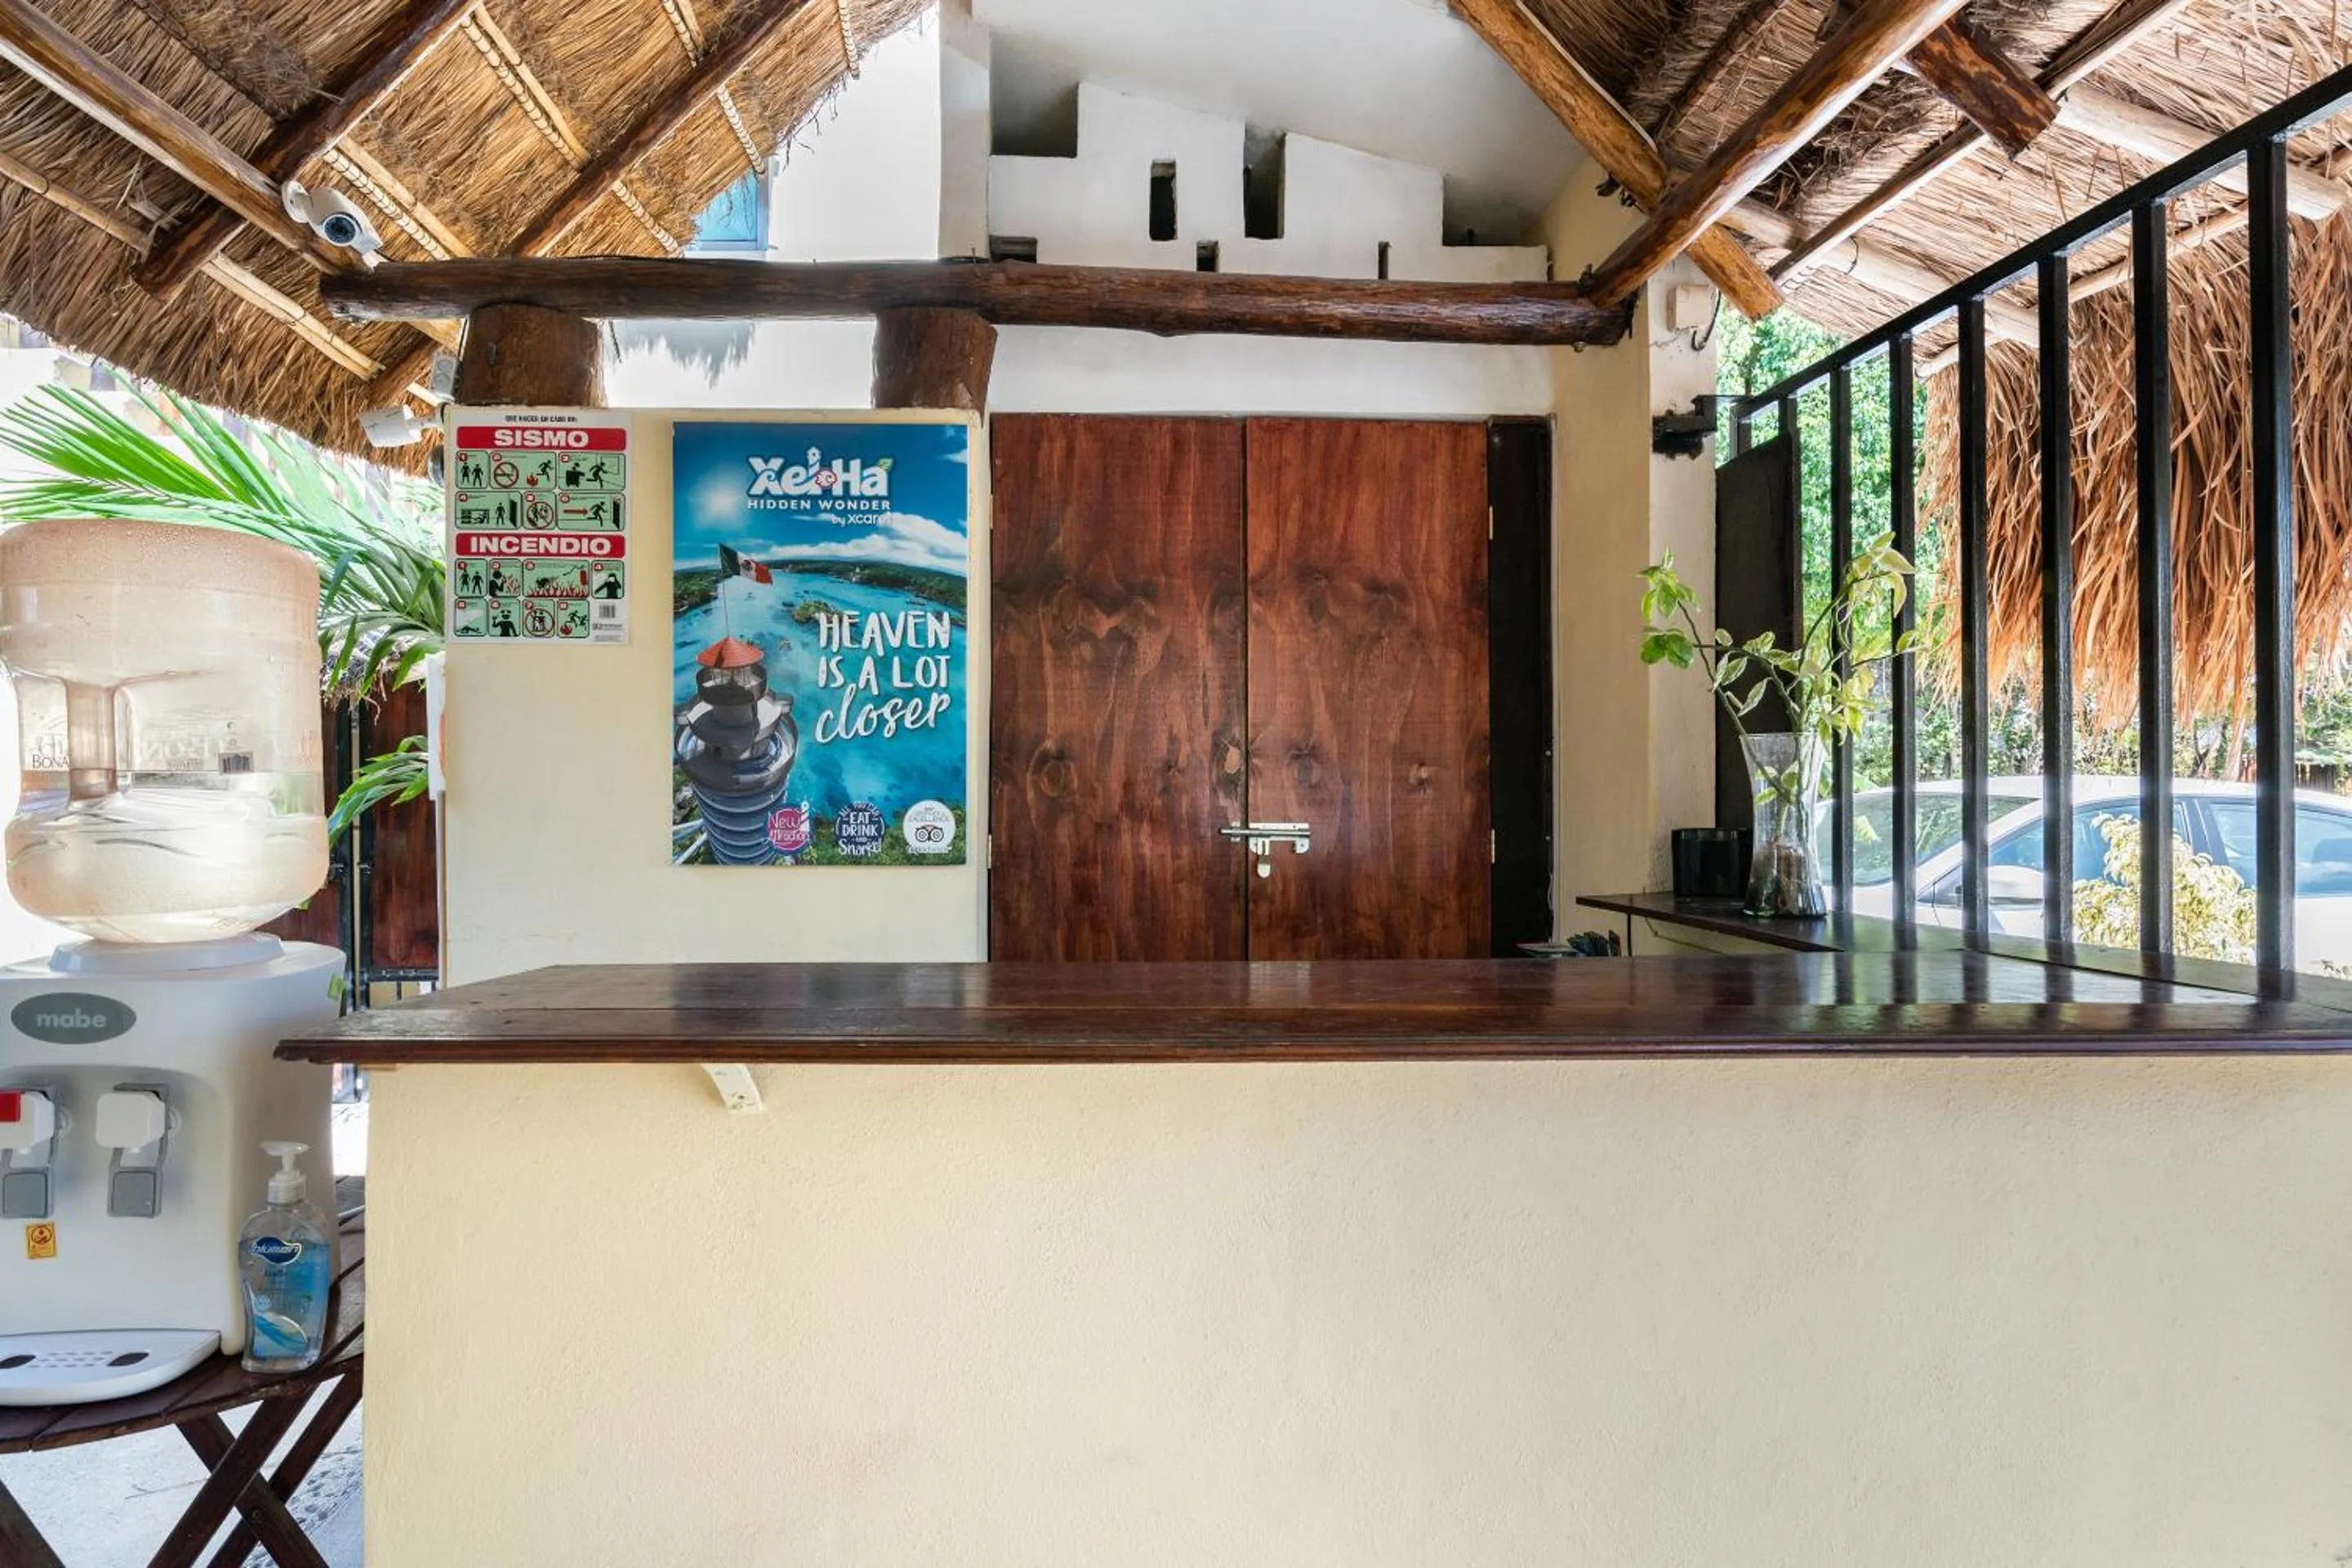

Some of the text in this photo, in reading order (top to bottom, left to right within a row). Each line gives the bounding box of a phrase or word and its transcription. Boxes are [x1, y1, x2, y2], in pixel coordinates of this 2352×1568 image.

[493, 430, 589, 448] SISMO
[747, 499, 891, 510] HIDDEN WONDER
[831, 514, 845, 527] by
[470, 536, 611, 555] INCENDIO
[818, 610, 951, 657] HEAVEN
[817, 655, 951, 696] IS A LOT
[815, 683, 951, 744] closer
[849, 812, 871, 824] EAT
[842, 824, 878, 836] DRINK
[36, 1007, 108, 1028] mabe
